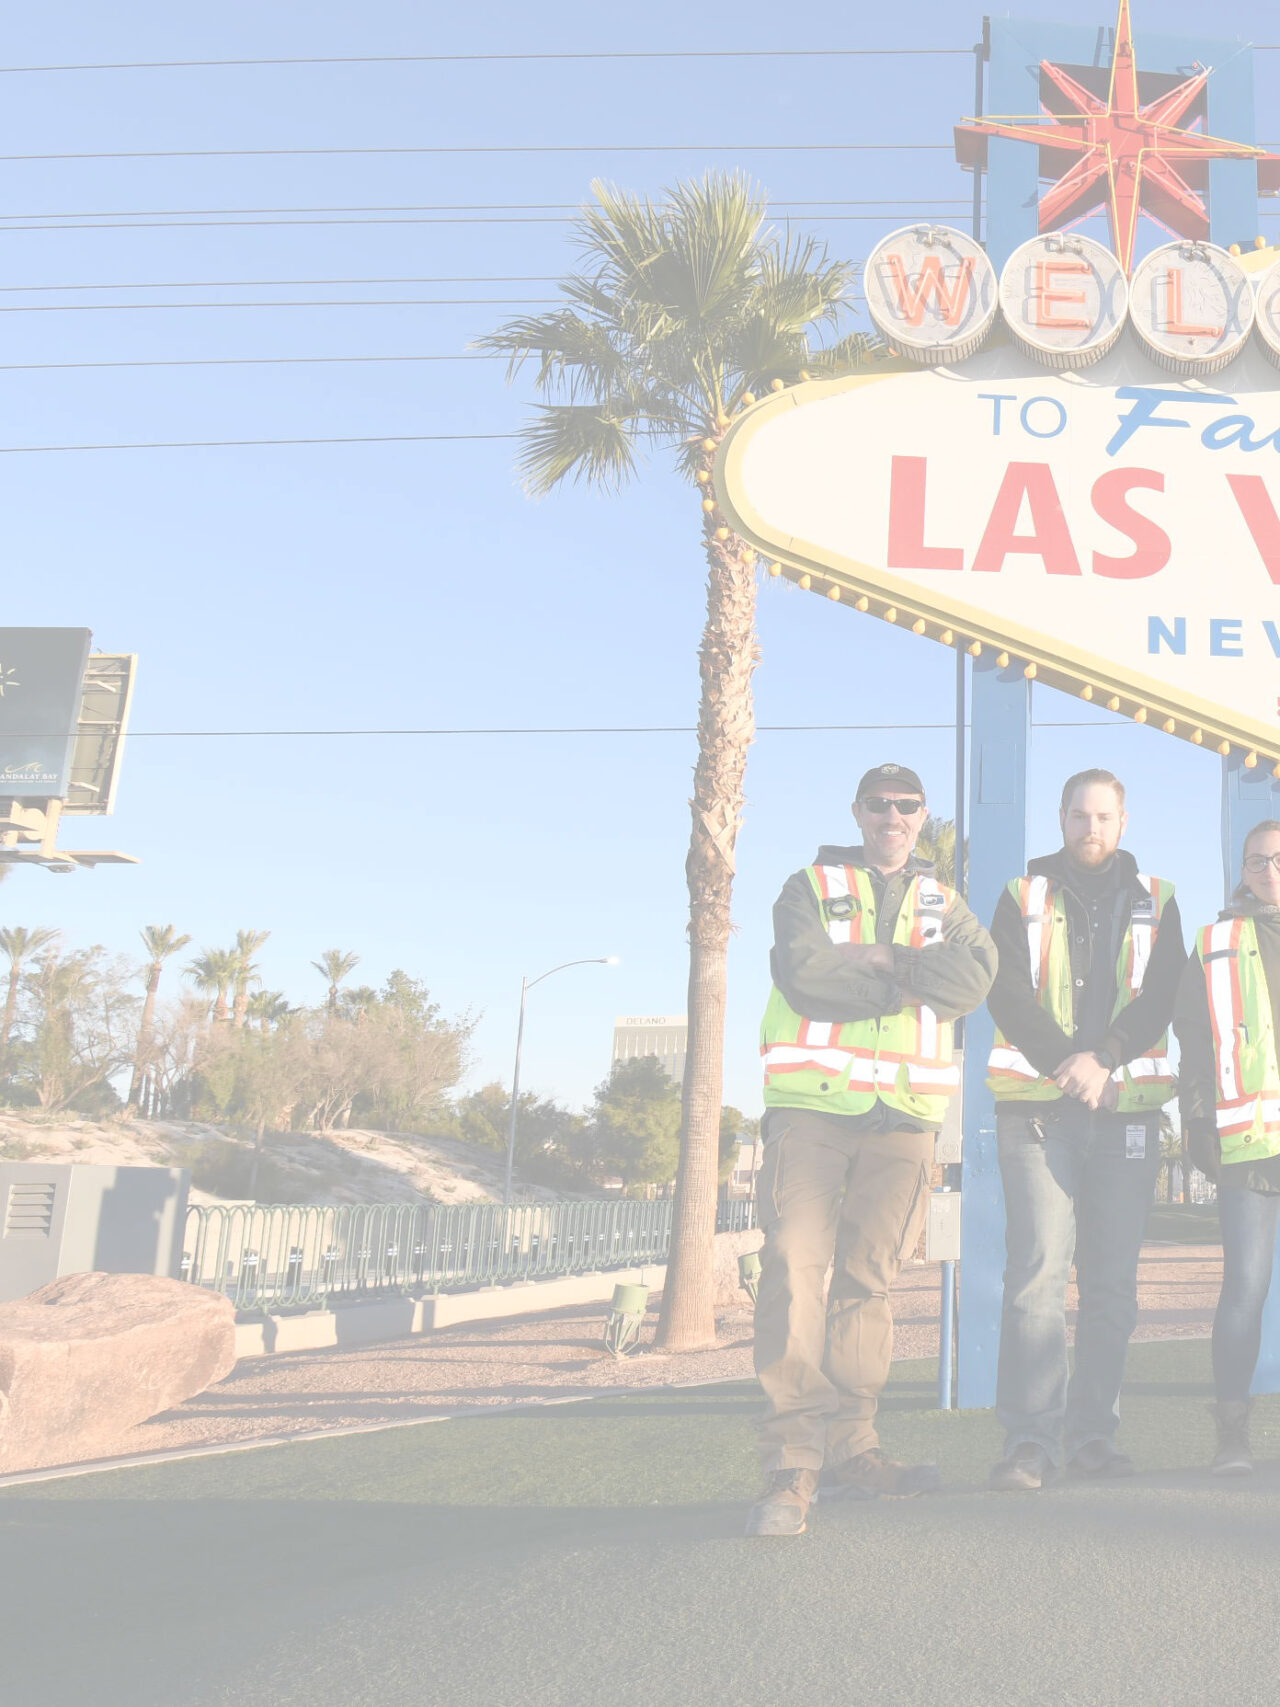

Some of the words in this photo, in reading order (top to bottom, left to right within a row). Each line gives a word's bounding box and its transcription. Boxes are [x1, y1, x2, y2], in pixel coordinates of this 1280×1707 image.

[977, 393, 1068, 438] TO
[886, 454, 1172, 580] LAS
[626, 1016, 667, 1025] DELANO
